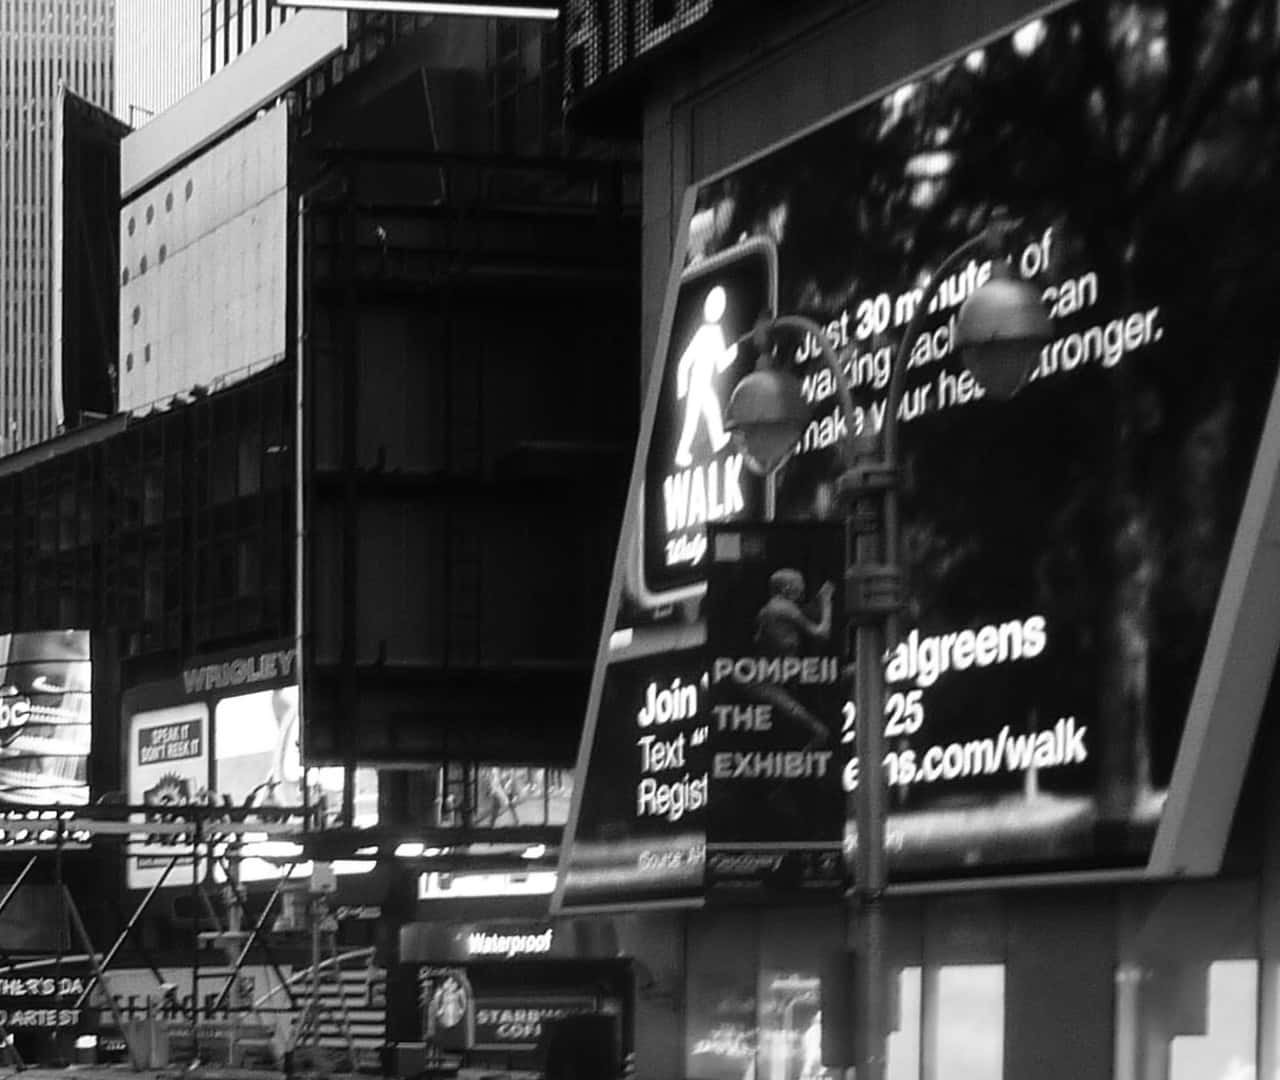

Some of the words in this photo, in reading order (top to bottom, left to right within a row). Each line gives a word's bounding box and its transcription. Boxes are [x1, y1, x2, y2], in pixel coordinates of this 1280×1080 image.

[855, 293, 891, 341] 30
[1020, 226, 1053, 279] of
[872, 382, 932, 436] yur
[1029, 305, 1163, 381] tronger.
[663, 453, 743, 533] WALK
[183, 648, 298, 694] WRIGLEY
[713, 655, 839, 684] POMPEII
[882, 614, 1047, 688] algreens
[638, 676, 698, 729] Join
[713, 703, 773, 732] THE
[151, 726, 181, 746] SPEAK
[180, 723, 190, 740] IT
[639, 732, 687, 774] Text
[713, 750, 833, 779] EXHIBIT
[468, 928, 553, 959] Waterproof
